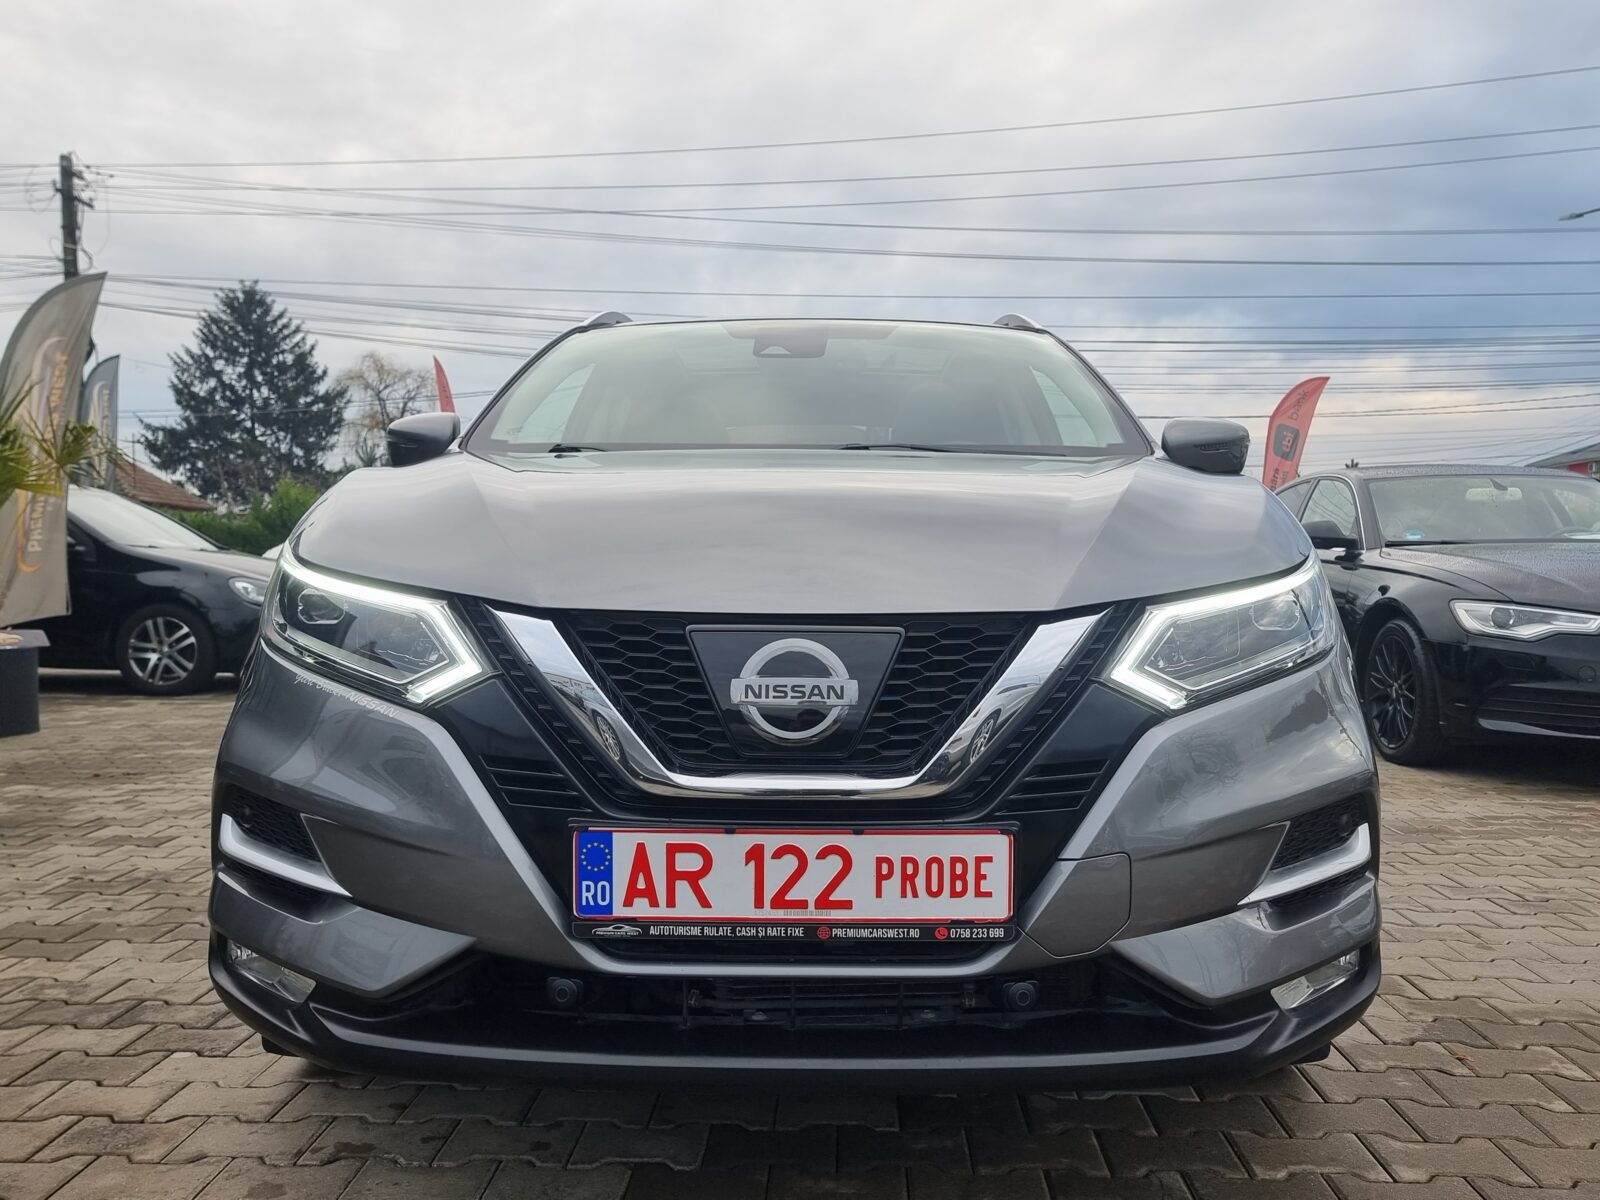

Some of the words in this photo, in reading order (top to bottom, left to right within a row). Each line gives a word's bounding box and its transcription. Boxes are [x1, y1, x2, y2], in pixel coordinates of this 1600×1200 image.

[1288, 390, 1309, 421] bank
[744, 684, 844, 700] NISSAN
[346, 692, 400, 718] NISSAN
[622, 842, 713, 908] AR
[744, 843, 853, 910] 122
[875, 856, 993, 898] PROBE
[581, 881, 610, 906] RO
[649, 925, 702, 936] AUTOTURISME
[703, 926, 735, 938] RULATE,
[736, 927, 756, 937] CASH
[766, 927, 786, 937] RATE
[787, 927, 805, 937] FIXE
[832, 928, 920, 938] PREMIUMCARSWEST.RO
[950, 928, 971, 938] 0758
[972, 928, 988, 938] 233
[988, 928, 1005, 938] 699
